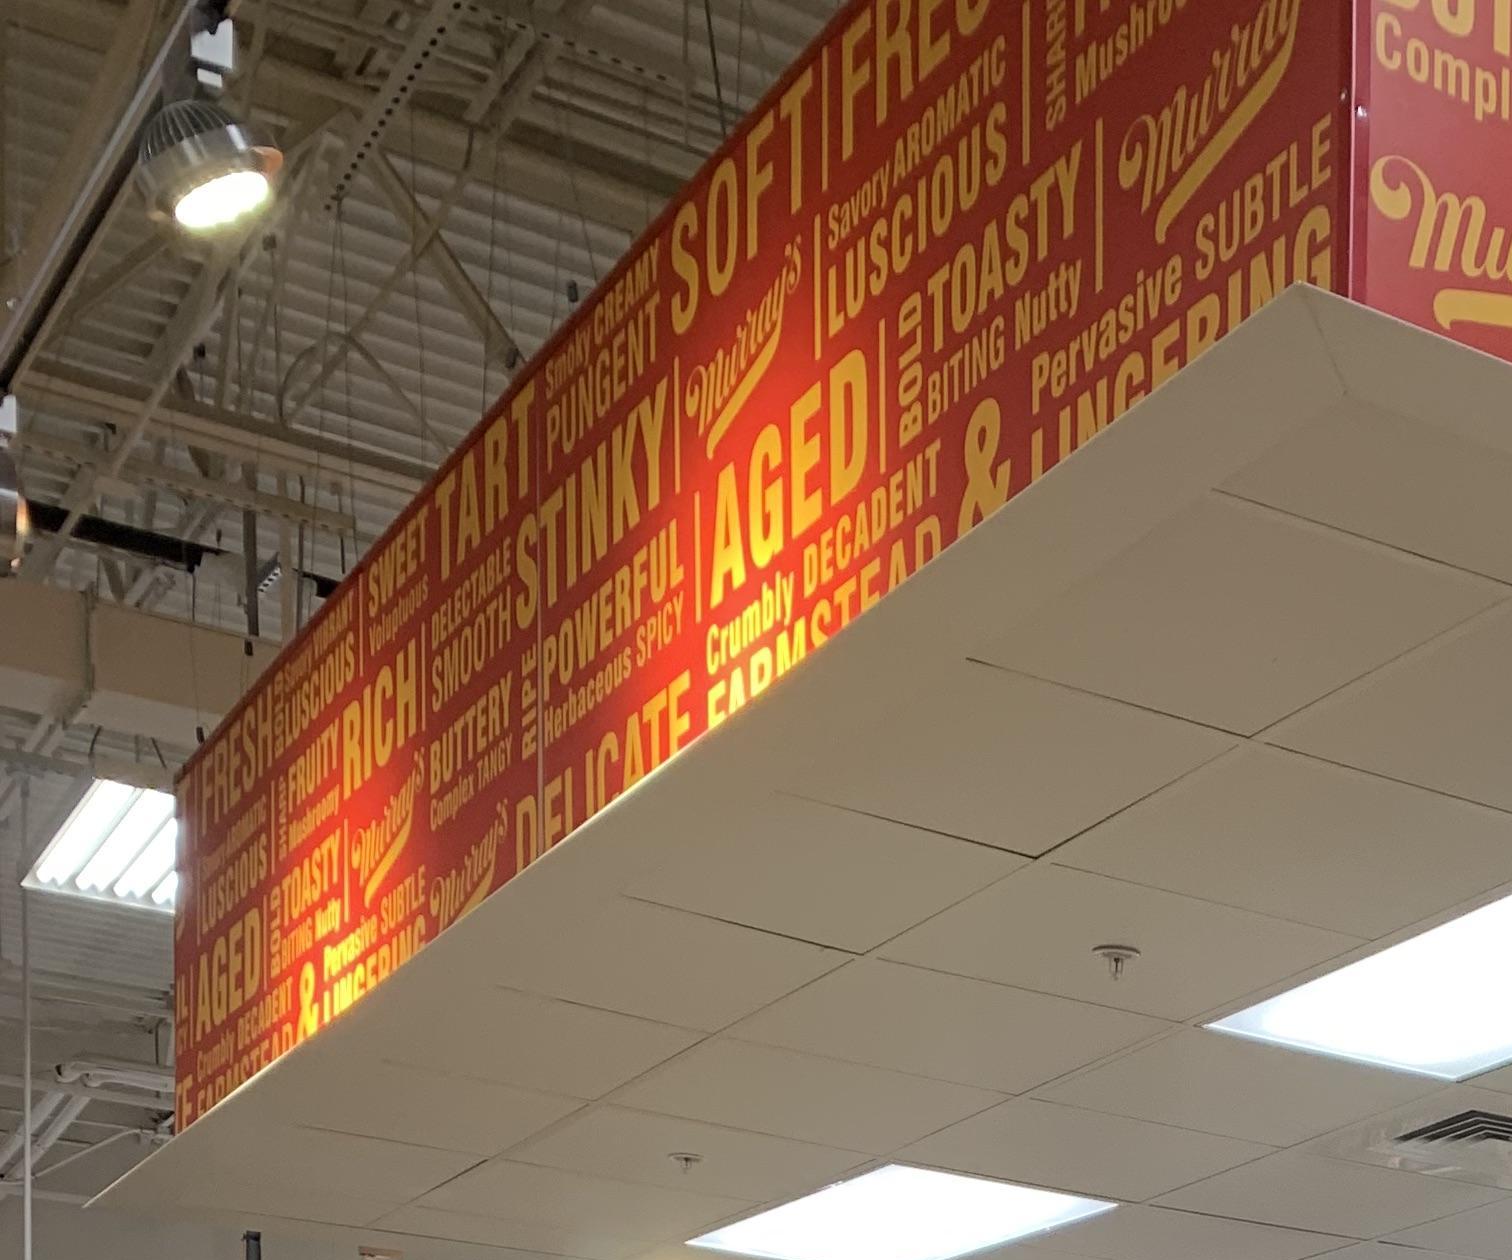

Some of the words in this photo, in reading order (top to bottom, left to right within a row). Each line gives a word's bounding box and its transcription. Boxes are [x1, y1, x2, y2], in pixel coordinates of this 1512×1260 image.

[672, 66, 813, 336] SOFT
[828, 159, 891, 250] Savory
[894, 34, 1006, 187] AROMATIC
[828, 101, 1007, 338] LUSCIOUS
[1195, 112, 1332, 281] SUBTLE
[928, 139, 1082, 354] TOASTY
[547, 291, 660, 474] PUNGENT
[686, 235, 802, 460] Murray's
[899, 291, 923, 449] BOLD
[928, 315, 1005, 425] BITING
[1015, 259, 1082, 351] Nutty
[1032, 254, 1183, 416] Pervasive
[435, 373, 535, 581] TART
[516, 376, 668, 629] STINKY
[711, 348, 867, 609] AGED
[368, 505, 429, 618] SWEET
[431, 537, 512, 650] DELECTABLE
[543, 518, 685, 701] POWERFUL
[706, 571, 795, 675] Crumbly
[803, 439, 941, 600] DECADENT
[284, 631, 355, 750] LUSCIOUS
[343, 638, 416, 800] RICH
[432, 585, 511, 714] SMOOTH
[521, 643, 538, 761] RIPE
[544, 645, 631, 748] Herbaceous
[636, 590, 684, 668] SPICY
[202, 684, 273, 837] FRESH
[289, 717, 340, 813] FRUITY
[430, 670, 513, 796] BUTTERY
[430, 774, 475, 832] Complex
[477, 733, 513, 794] TANGY
[202, 833, 268, 935] LUSCIOUS
[281, 825, 340, 927] TOASTY
[352, 746, 425, 909] Murray's
[380, 865, 426, 935] SUBTLE
[430, 797, 508, 932] Murray's
[197, 908, 260, 1042] AGED
[238, 977, 293, 1050] DECADENT
